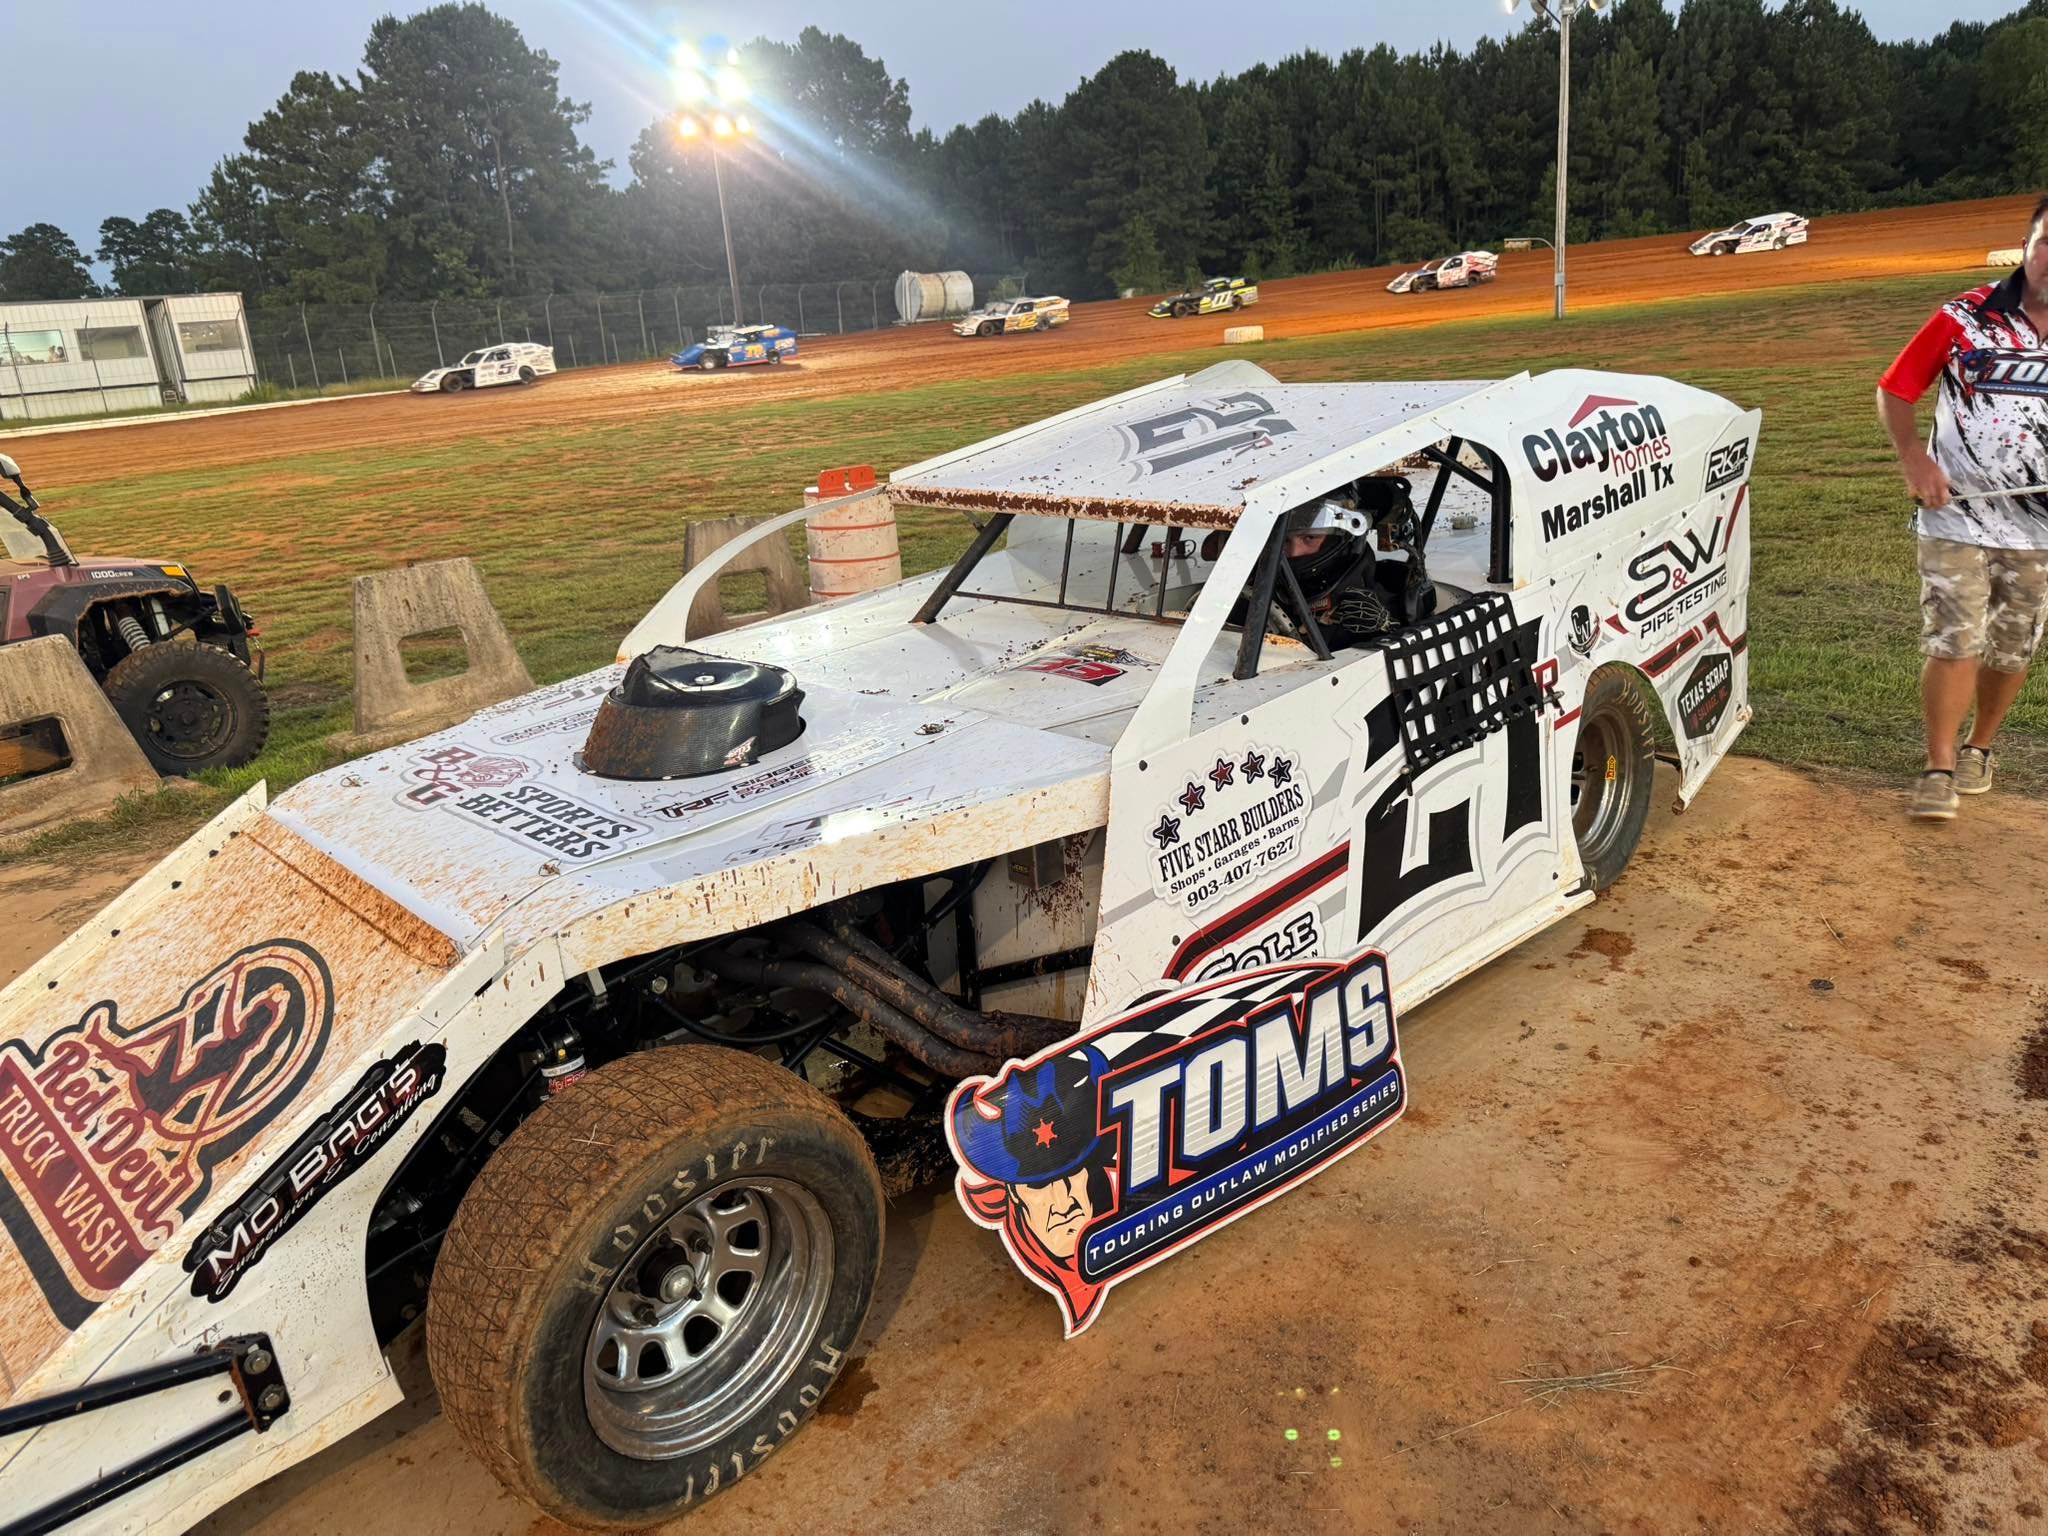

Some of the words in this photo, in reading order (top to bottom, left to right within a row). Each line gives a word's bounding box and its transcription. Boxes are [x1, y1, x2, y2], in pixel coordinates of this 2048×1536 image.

[1522, 403, 1666, 482] Clayton
[1609, 434, 1671, 477] homes
[1541, 470, 1646, 543] Marshall
[1650, 461, 1675, 492] Tx
[1640, 606, 1676, 639] PIPE
[1676, 569, 1728, 618] TESTING
[1681, 680, 1704, 718] TEXAS
[1705, 659, 1729, 693] SCRAP
[456, 793, 611, 858] BETTERS
[501, 785, 637, 840] SPORTS
[1158, 840, 1195, 883] FIVE
[1197, 821, 1241, 863] STARR
[1241, 784, 1305, 838] BUILDERS
[1171, 868, 1207, 896] Shops
[1214, 838, 1260, 875] Garages
[1268, 815, 1300, 843] Barns
[1186, 834, 1296, 908] 903-407-7627
[1111, 964, 1390, 1193] TOMS
[0, 1084, 64, 1180] TRUCK
[55, 1171, 130, 1274] WASH
[36, 1041, 117, 1136] Red
[90, 1107, 193, 1240] Devil
[1089, 1204, 1184, 1261] TOURING
[1191, 1161, 1269, 1208] OUTLAW
[1274, 1114, 1349, 1168] MODIFIED
[1352, 1080, 1398, 1119] SERIES
[216, 1185, 319, 1295] Suspension
[354, 1072, 439, 1155] Consulting
[208, 1197, 279, 1275] MO
